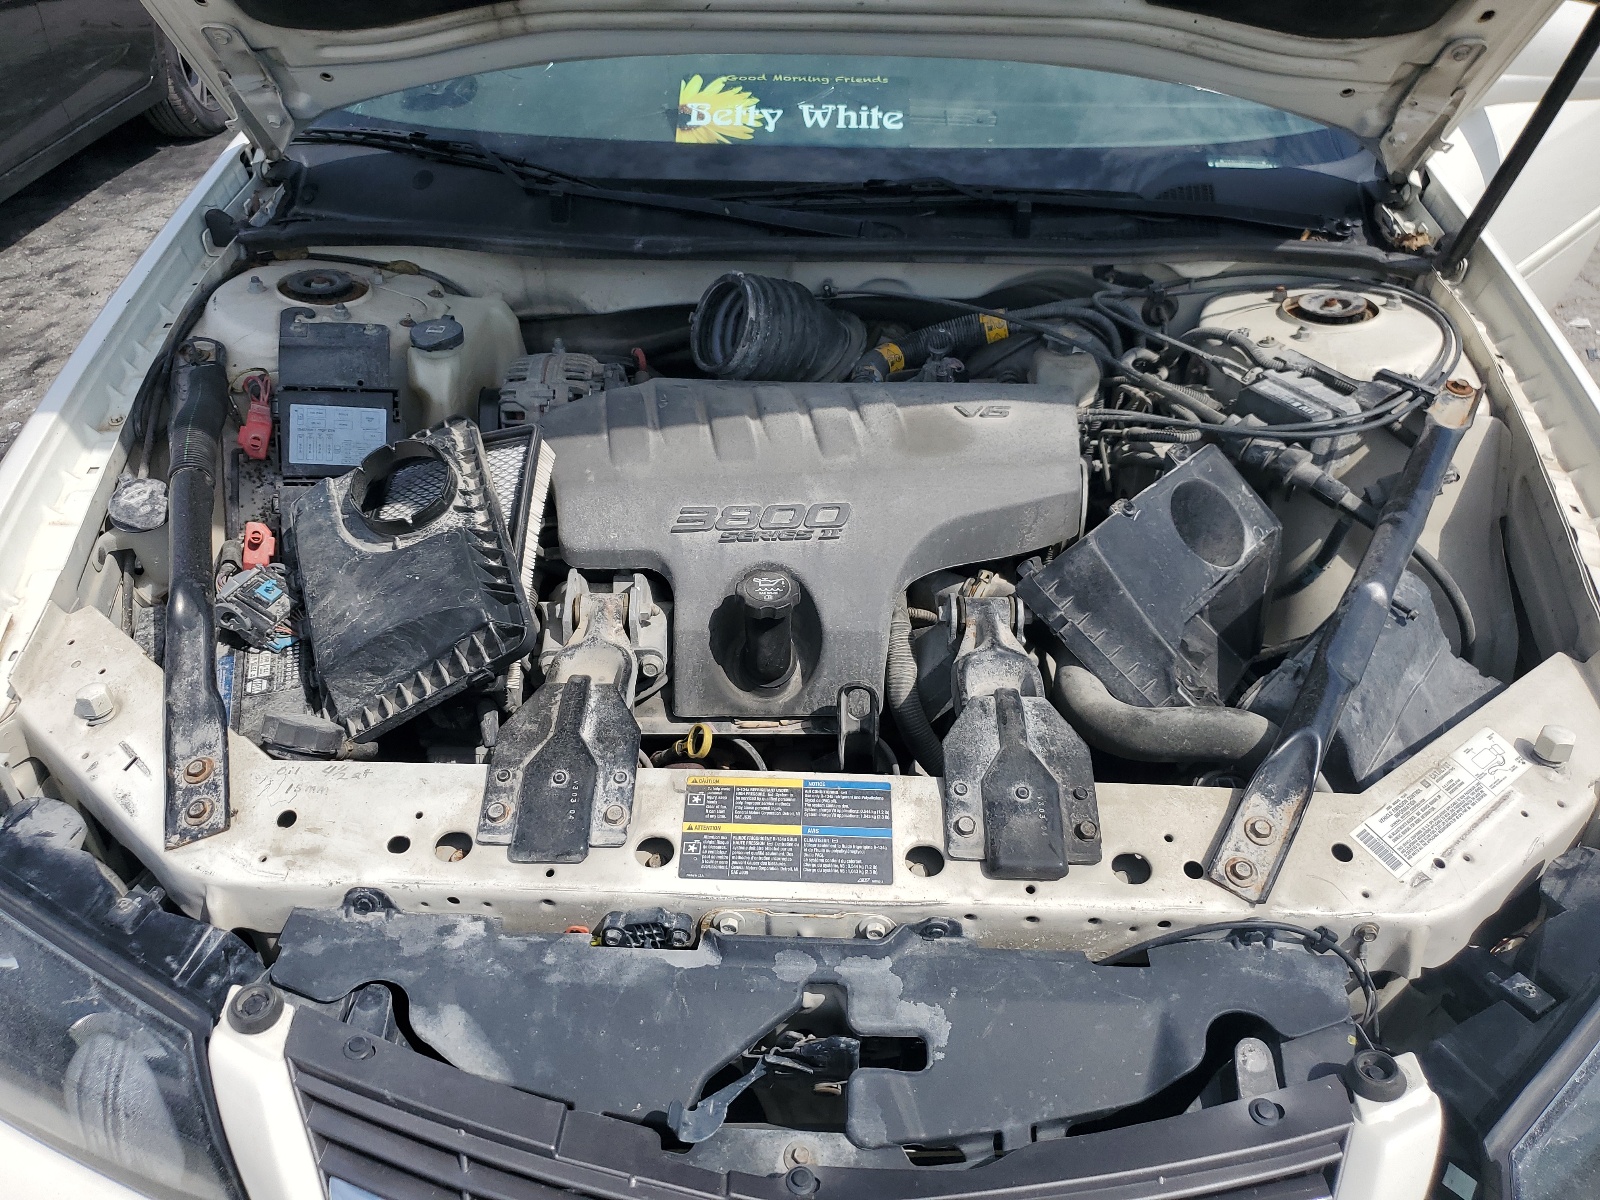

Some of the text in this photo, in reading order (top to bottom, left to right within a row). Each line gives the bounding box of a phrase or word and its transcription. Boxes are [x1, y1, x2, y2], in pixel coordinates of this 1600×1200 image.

[726, 74, 767, 82] Good
[773, 75, 829, 84] Morning
[686, 102, 903, 132] Betty White
[953, 406, 1011, 418] V6
[670, 502, 851, 533] 3800
[718, 530, 814, 544] SERIES
